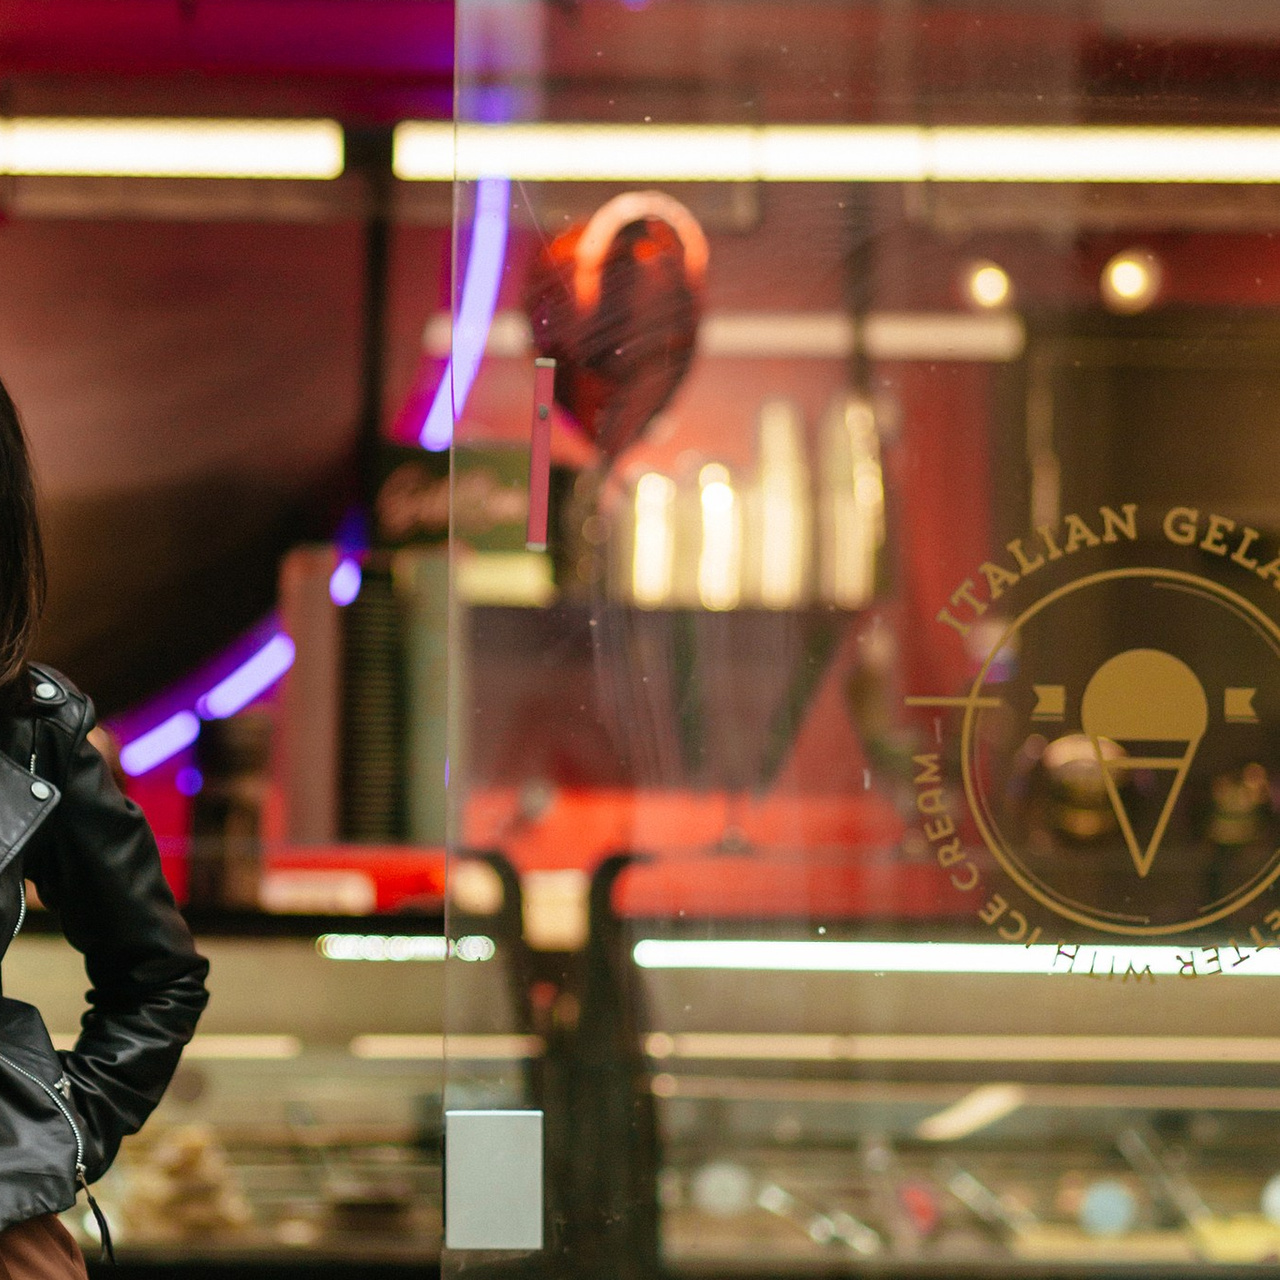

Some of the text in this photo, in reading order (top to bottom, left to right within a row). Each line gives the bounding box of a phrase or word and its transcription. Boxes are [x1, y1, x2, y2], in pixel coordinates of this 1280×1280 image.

[936, 503, 1138, 636] ITALIAN
[912, 753, 978, 891] CREAM
[979, 893, 1041, 948] ICE
[1054, 941, 1155, 983] WITH
